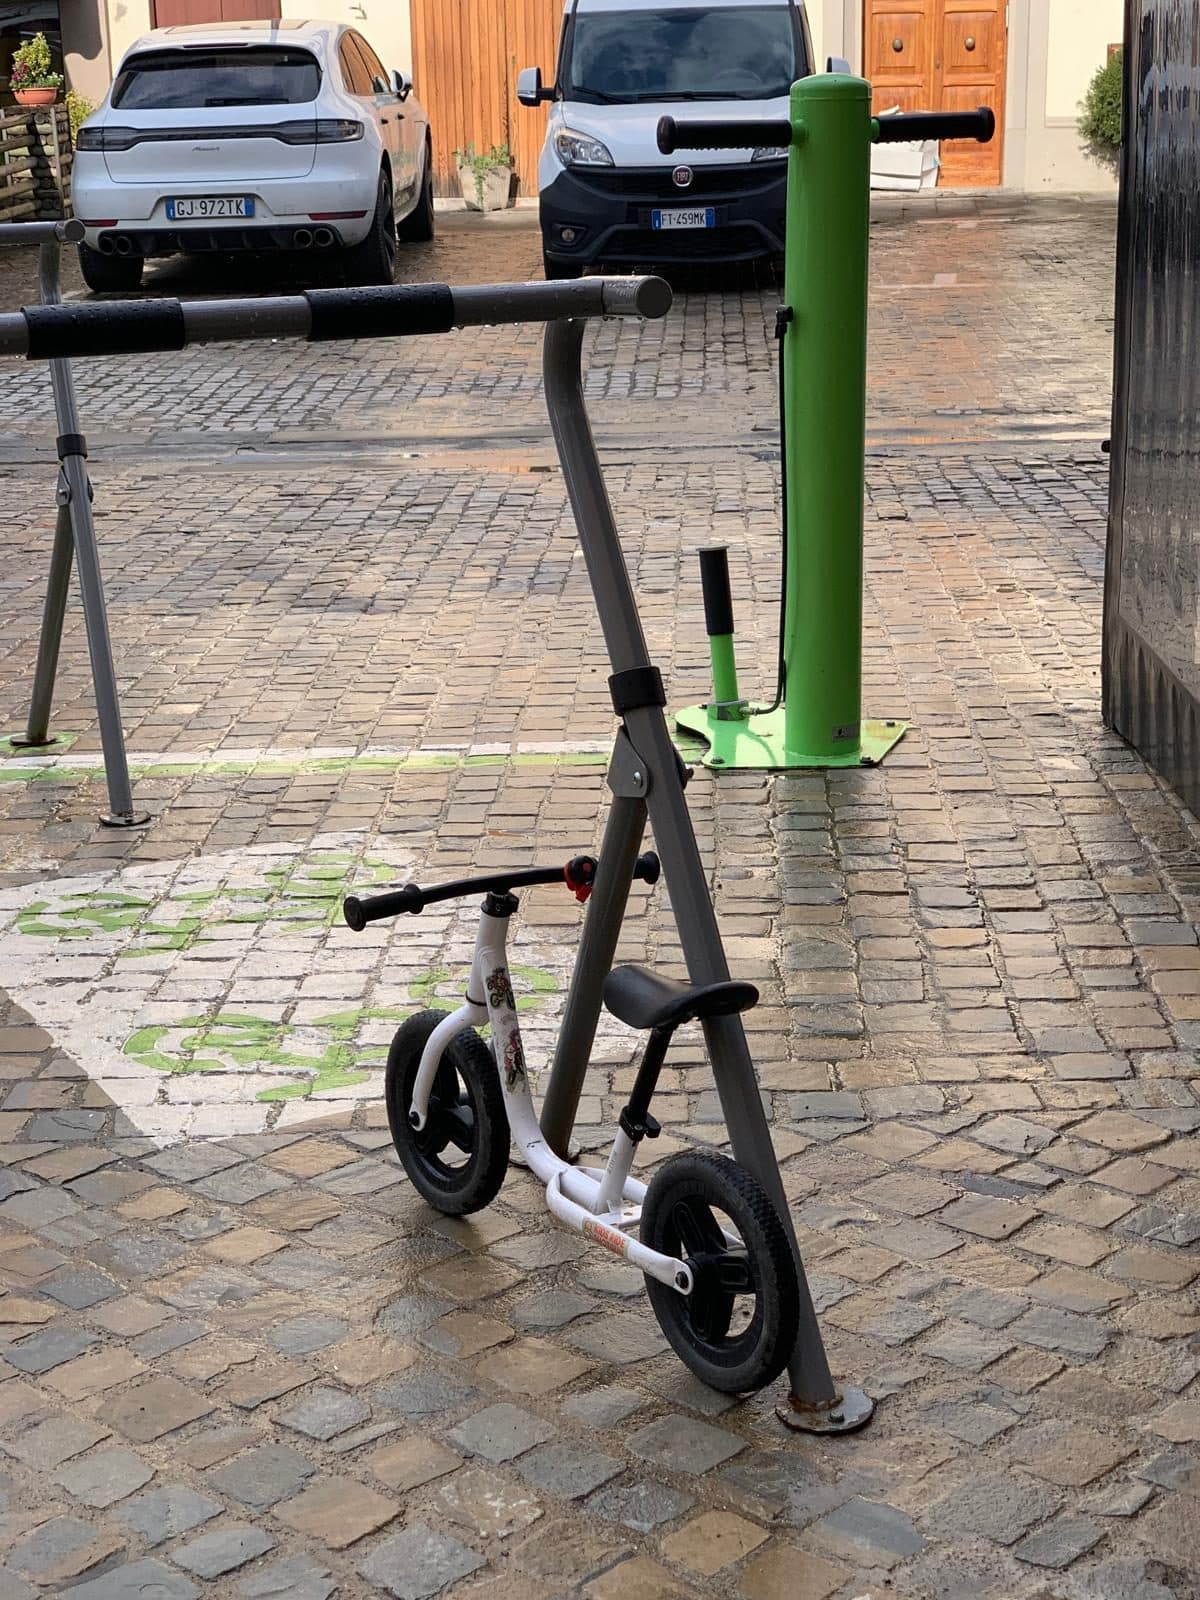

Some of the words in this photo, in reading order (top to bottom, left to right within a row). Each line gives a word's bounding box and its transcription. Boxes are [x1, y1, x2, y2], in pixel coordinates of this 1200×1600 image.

[676, 171, 689, 182] FIAT
[177, 201, 194, 216] GJ
[199, 199, 244, 215] 972TK
[676, 212, 705, 225] 459MK
